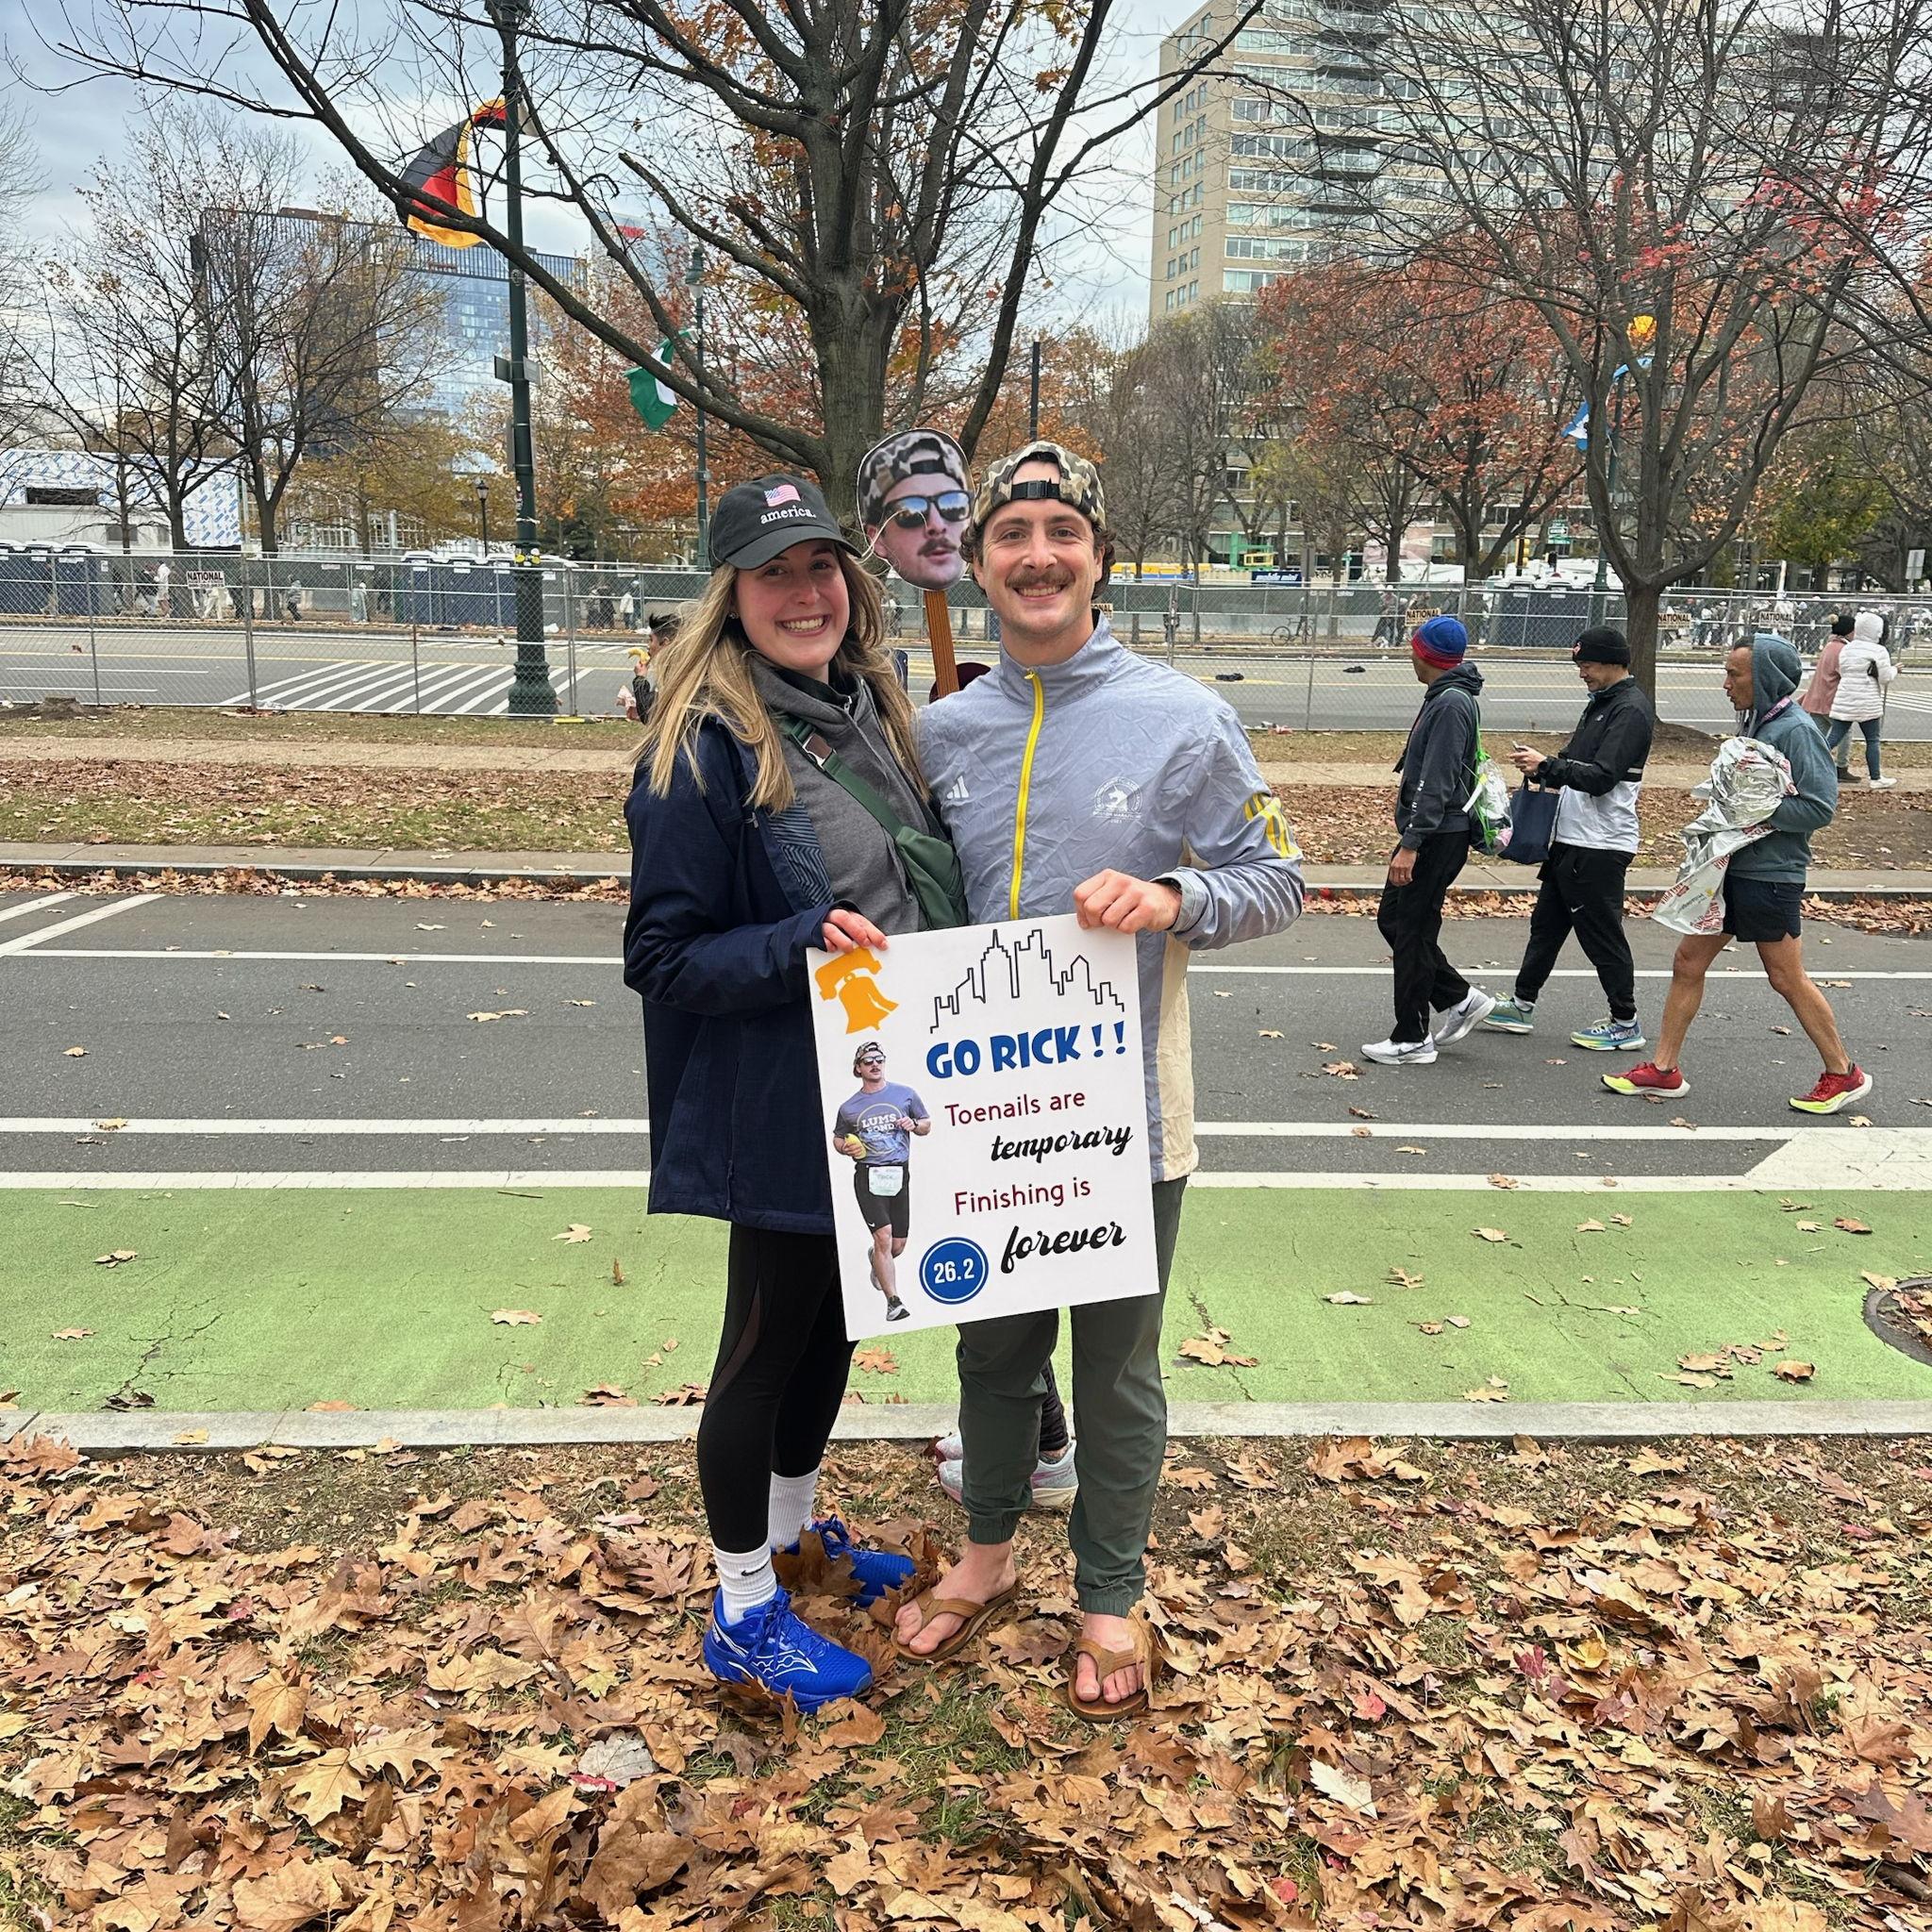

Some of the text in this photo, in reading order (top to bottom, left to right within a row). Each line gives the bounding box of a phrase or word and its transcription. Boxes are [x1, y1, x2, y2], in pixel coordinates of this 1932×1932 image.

[760, 505, 817, 525] america.
[188, 572, 223, 581] NATIONAL
[1760, 613, 1793, 623] NATIONAL
[926, 1040, 981, 1079] GO
[990, 1024, 1081, 1073] RICK
[861, 1113, 896, 1128] LUMS
[944, 1091, 1086, 1126] Toenails are
[991, 1125, 1133, 1163] temporary
[955, 1177, 1091, 1215] Finishing is
[1001, 1221, 1126, 1274] forever
[933, 1257, 975, 1284] 26.2
